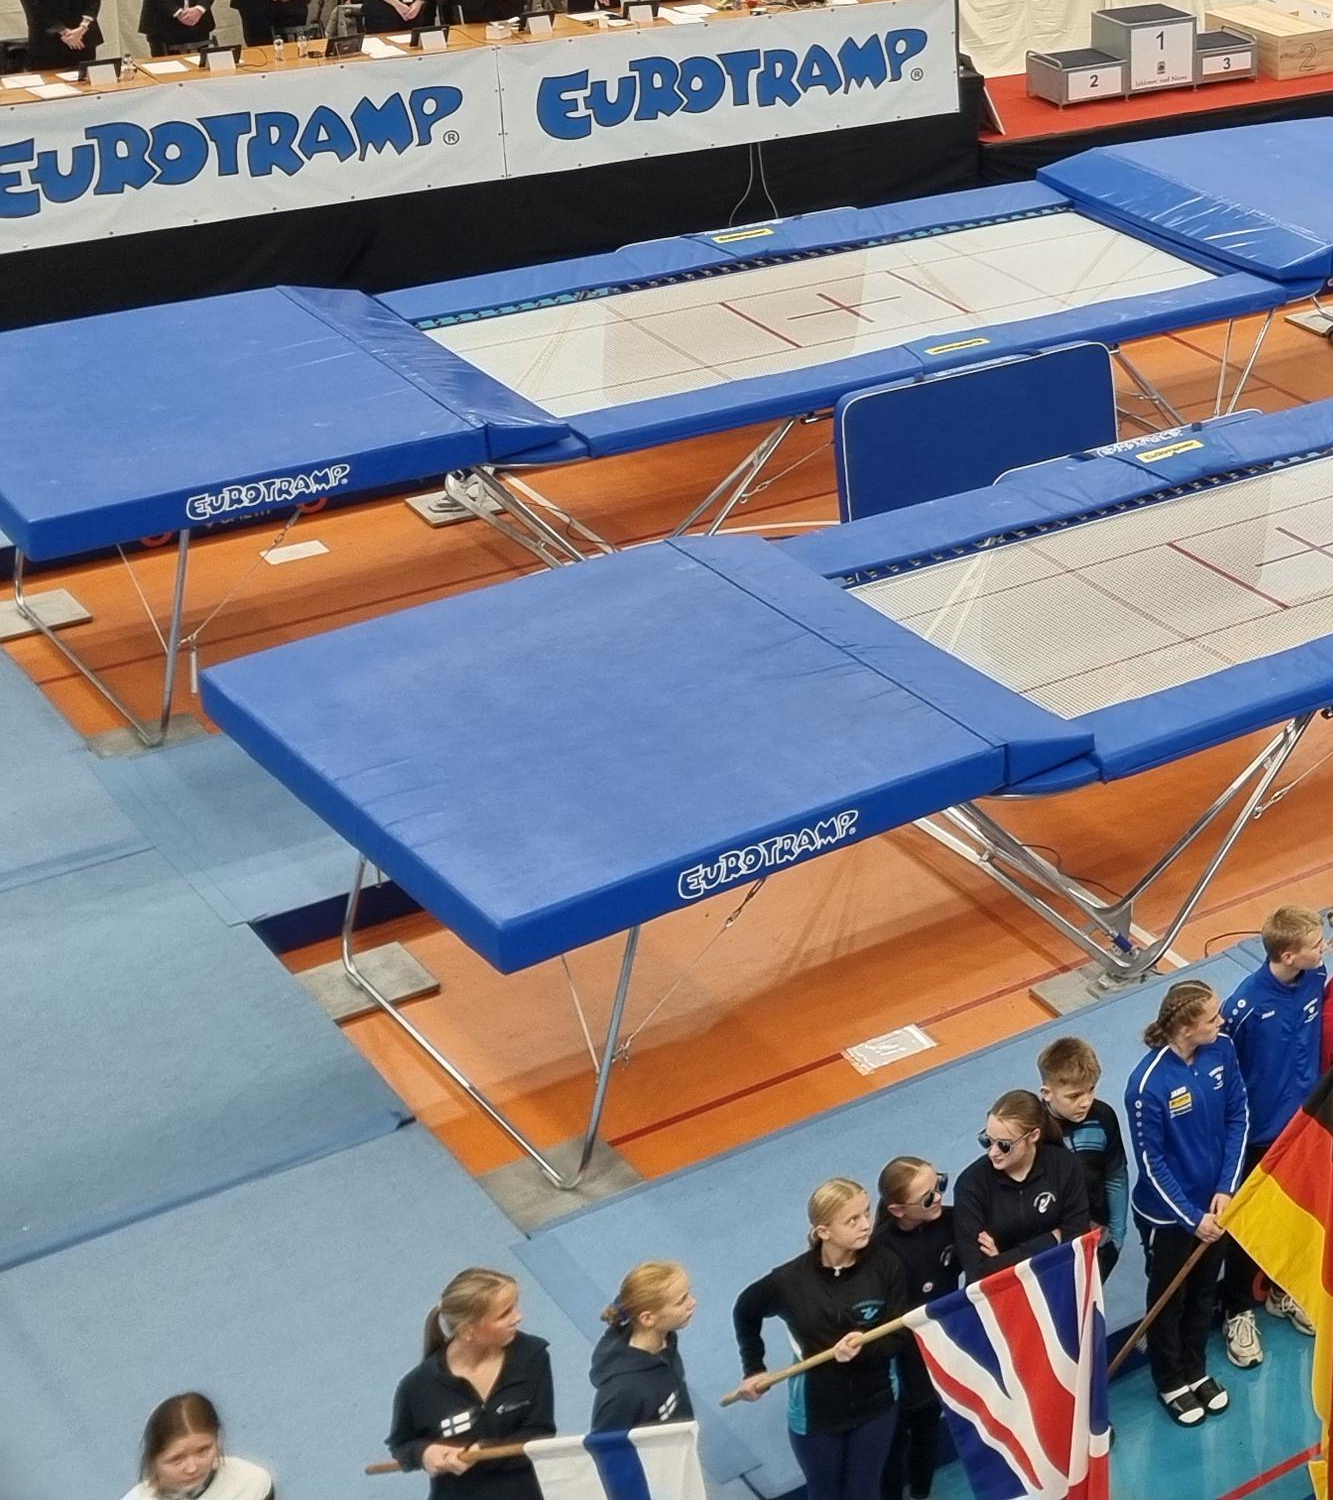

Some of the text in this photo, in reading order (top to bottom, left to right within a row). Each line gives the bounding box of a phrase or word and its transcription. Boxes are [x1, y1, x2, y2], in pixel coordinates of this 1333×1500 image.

[1156, 30, 1166, 51] 1
[1299, 42, 1317, 71] 2
[536, 28, 928, 141] EUROTRAMP
[1089, 74, 1099, 88] 2
[1222, 57, 1232, 70] 3
[0, 85, 464, 219] EUROTRAMP
[186, 464, 350, 521] EUROTRAMP
[678, 809, 859, 900] EUROTRAMP
